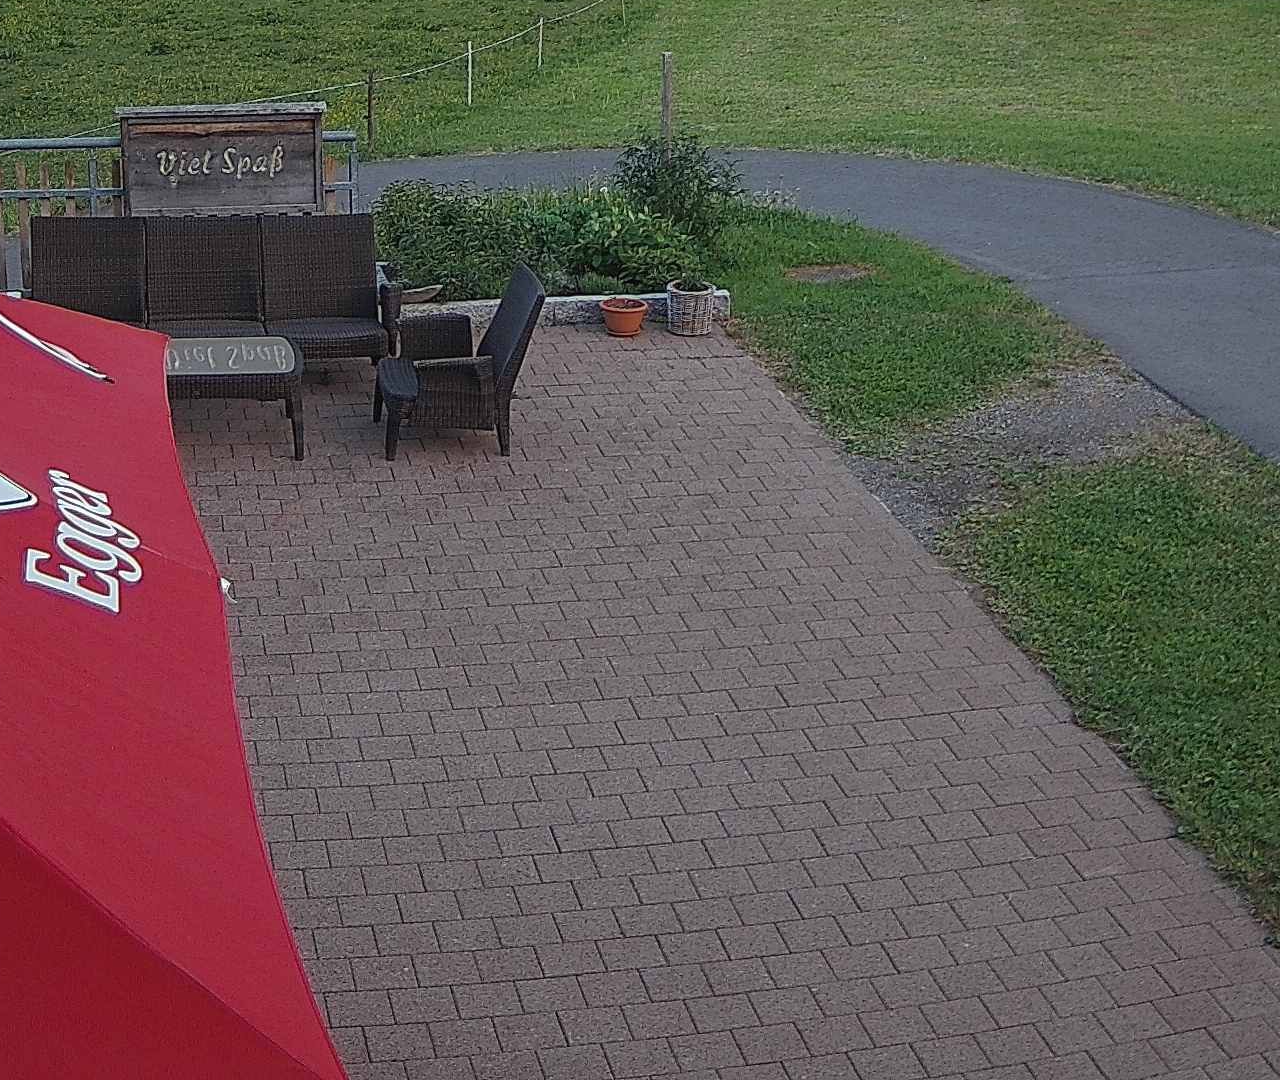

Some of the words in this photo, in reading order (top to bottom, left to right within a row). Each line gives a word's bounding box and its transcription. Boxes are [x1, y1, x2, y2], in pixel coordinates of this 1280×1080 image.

[157, 149, 212, 177] Viel
[221, 143, 283, 179] Spaß
[25, 469, 143, 613] Egger
